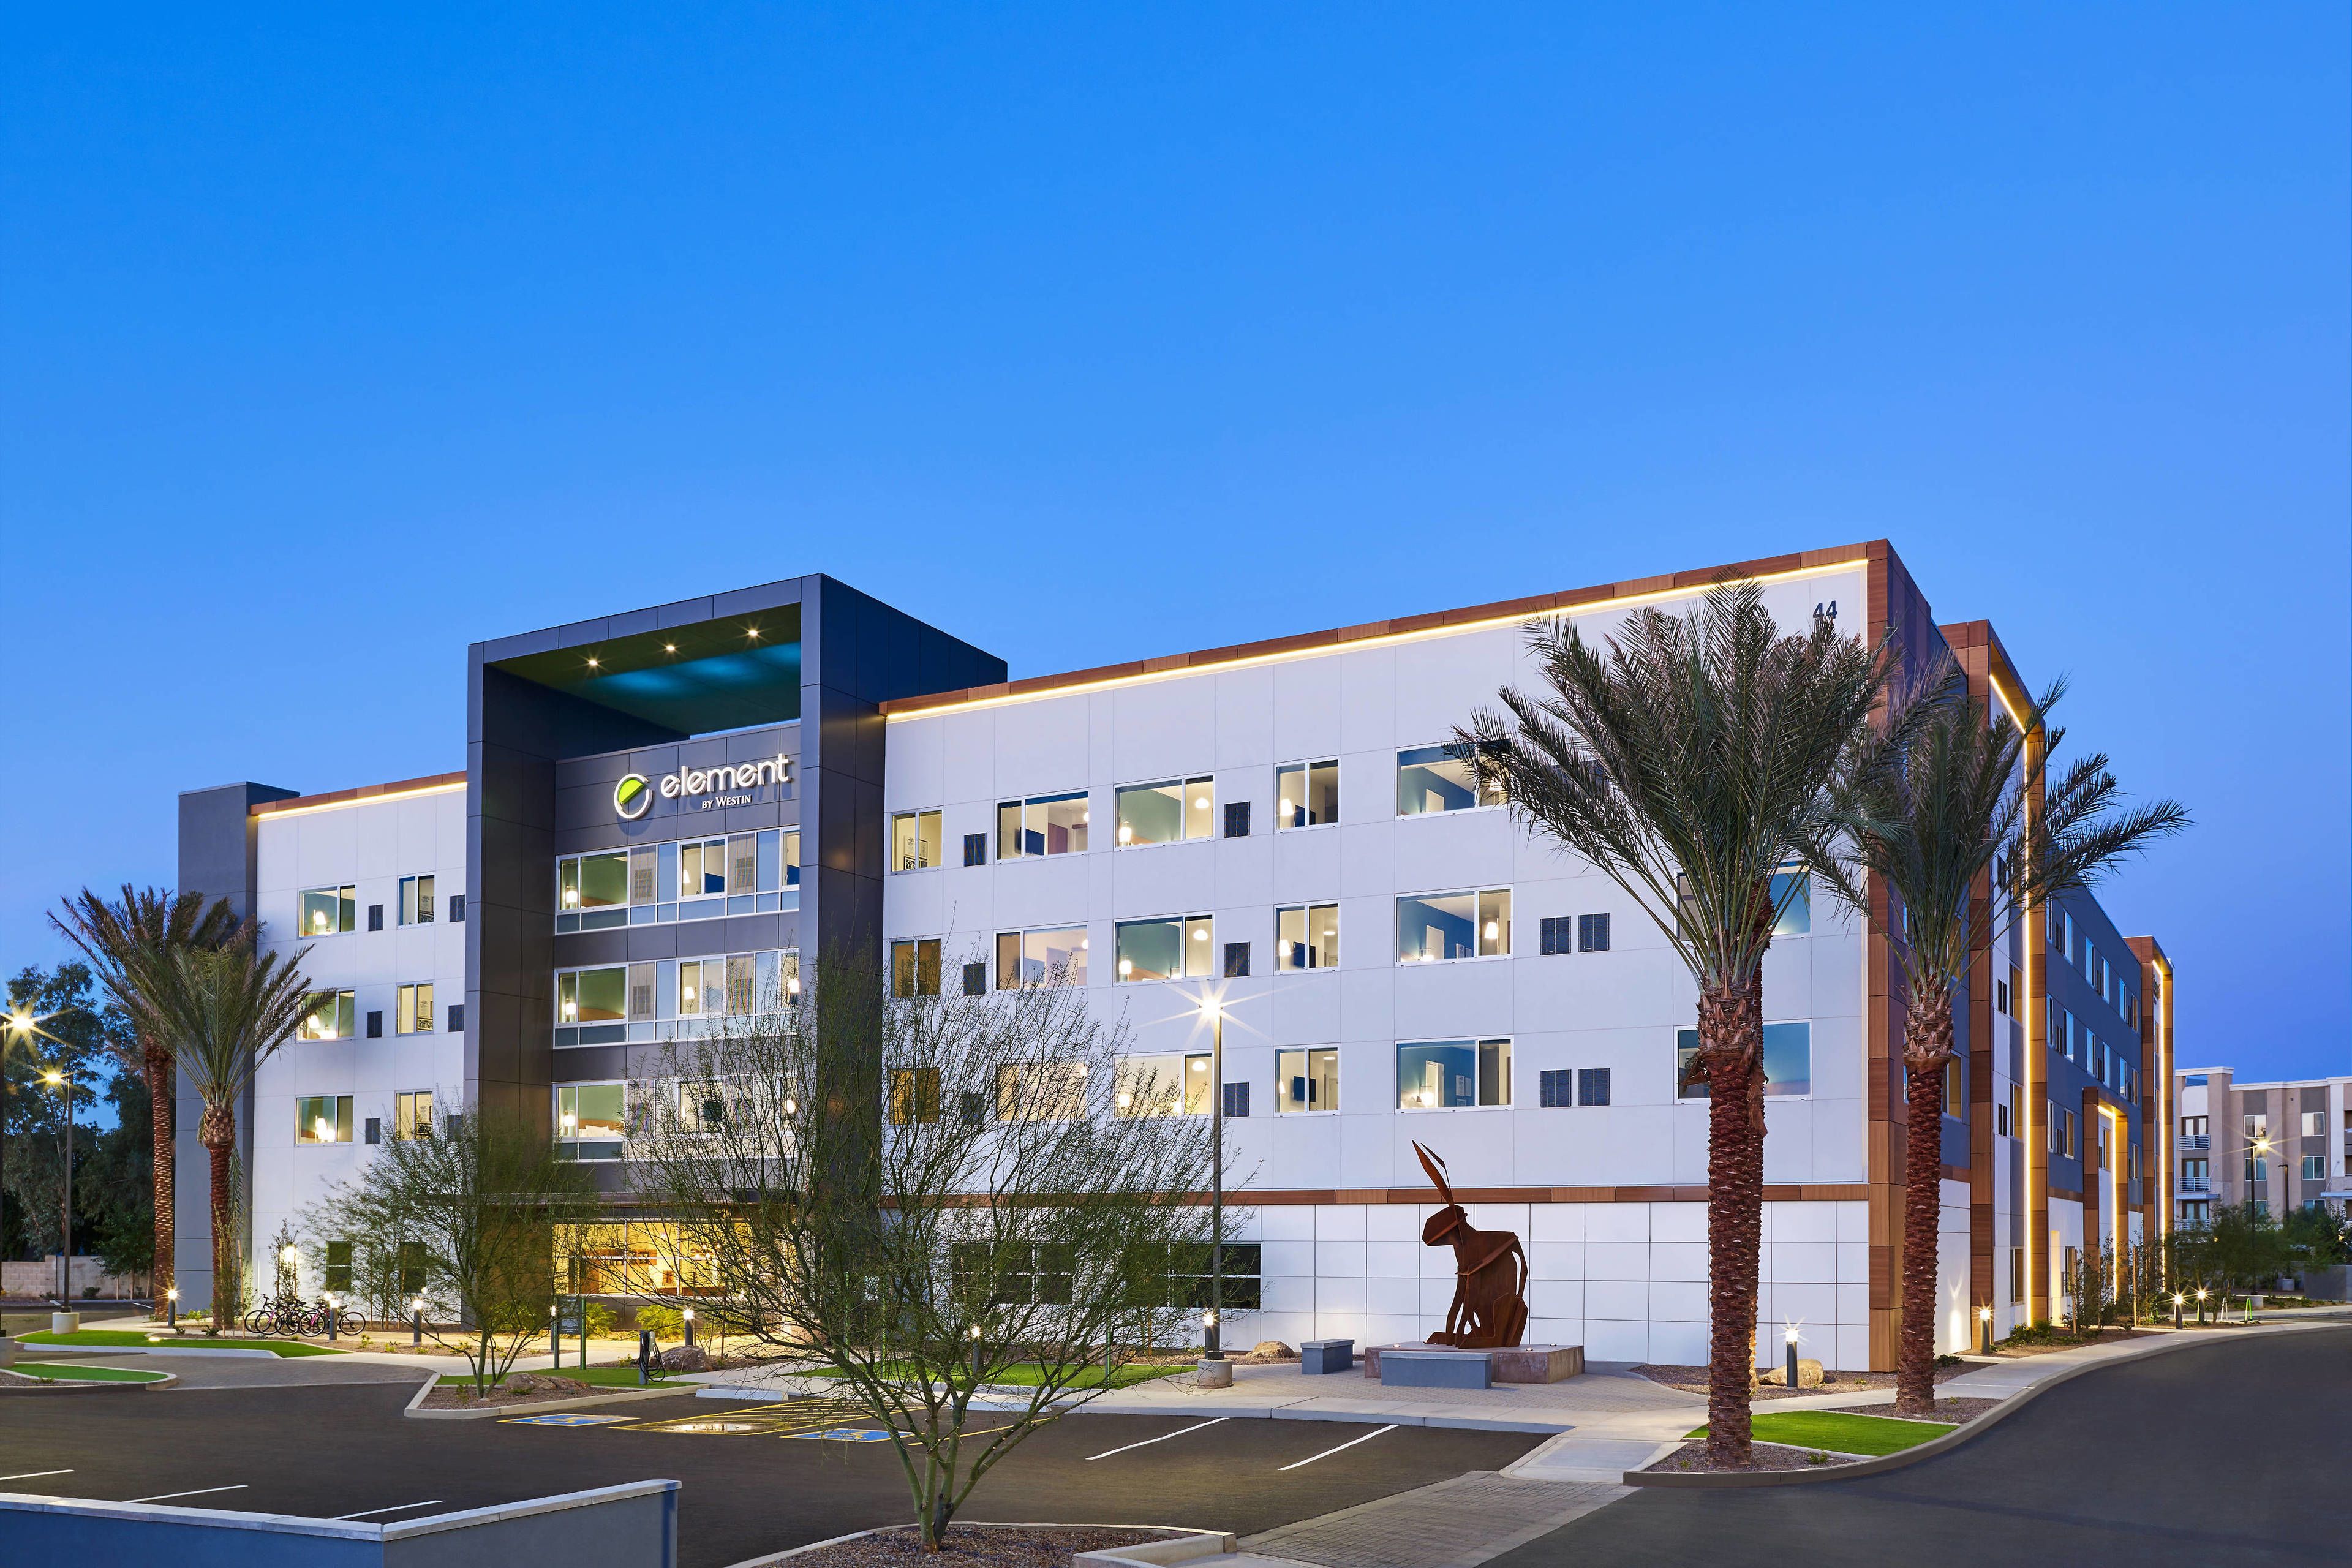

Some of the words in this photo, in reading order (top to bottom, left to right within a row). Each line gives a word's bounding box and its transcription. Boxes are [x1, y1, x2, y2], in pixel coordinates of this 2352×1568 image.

[1813, 600, 1838, 619] 44
[660, 753, 790, 798] element
[701, 799, 713, 809] BY
[715, 794, 752, 807] WESTIN
